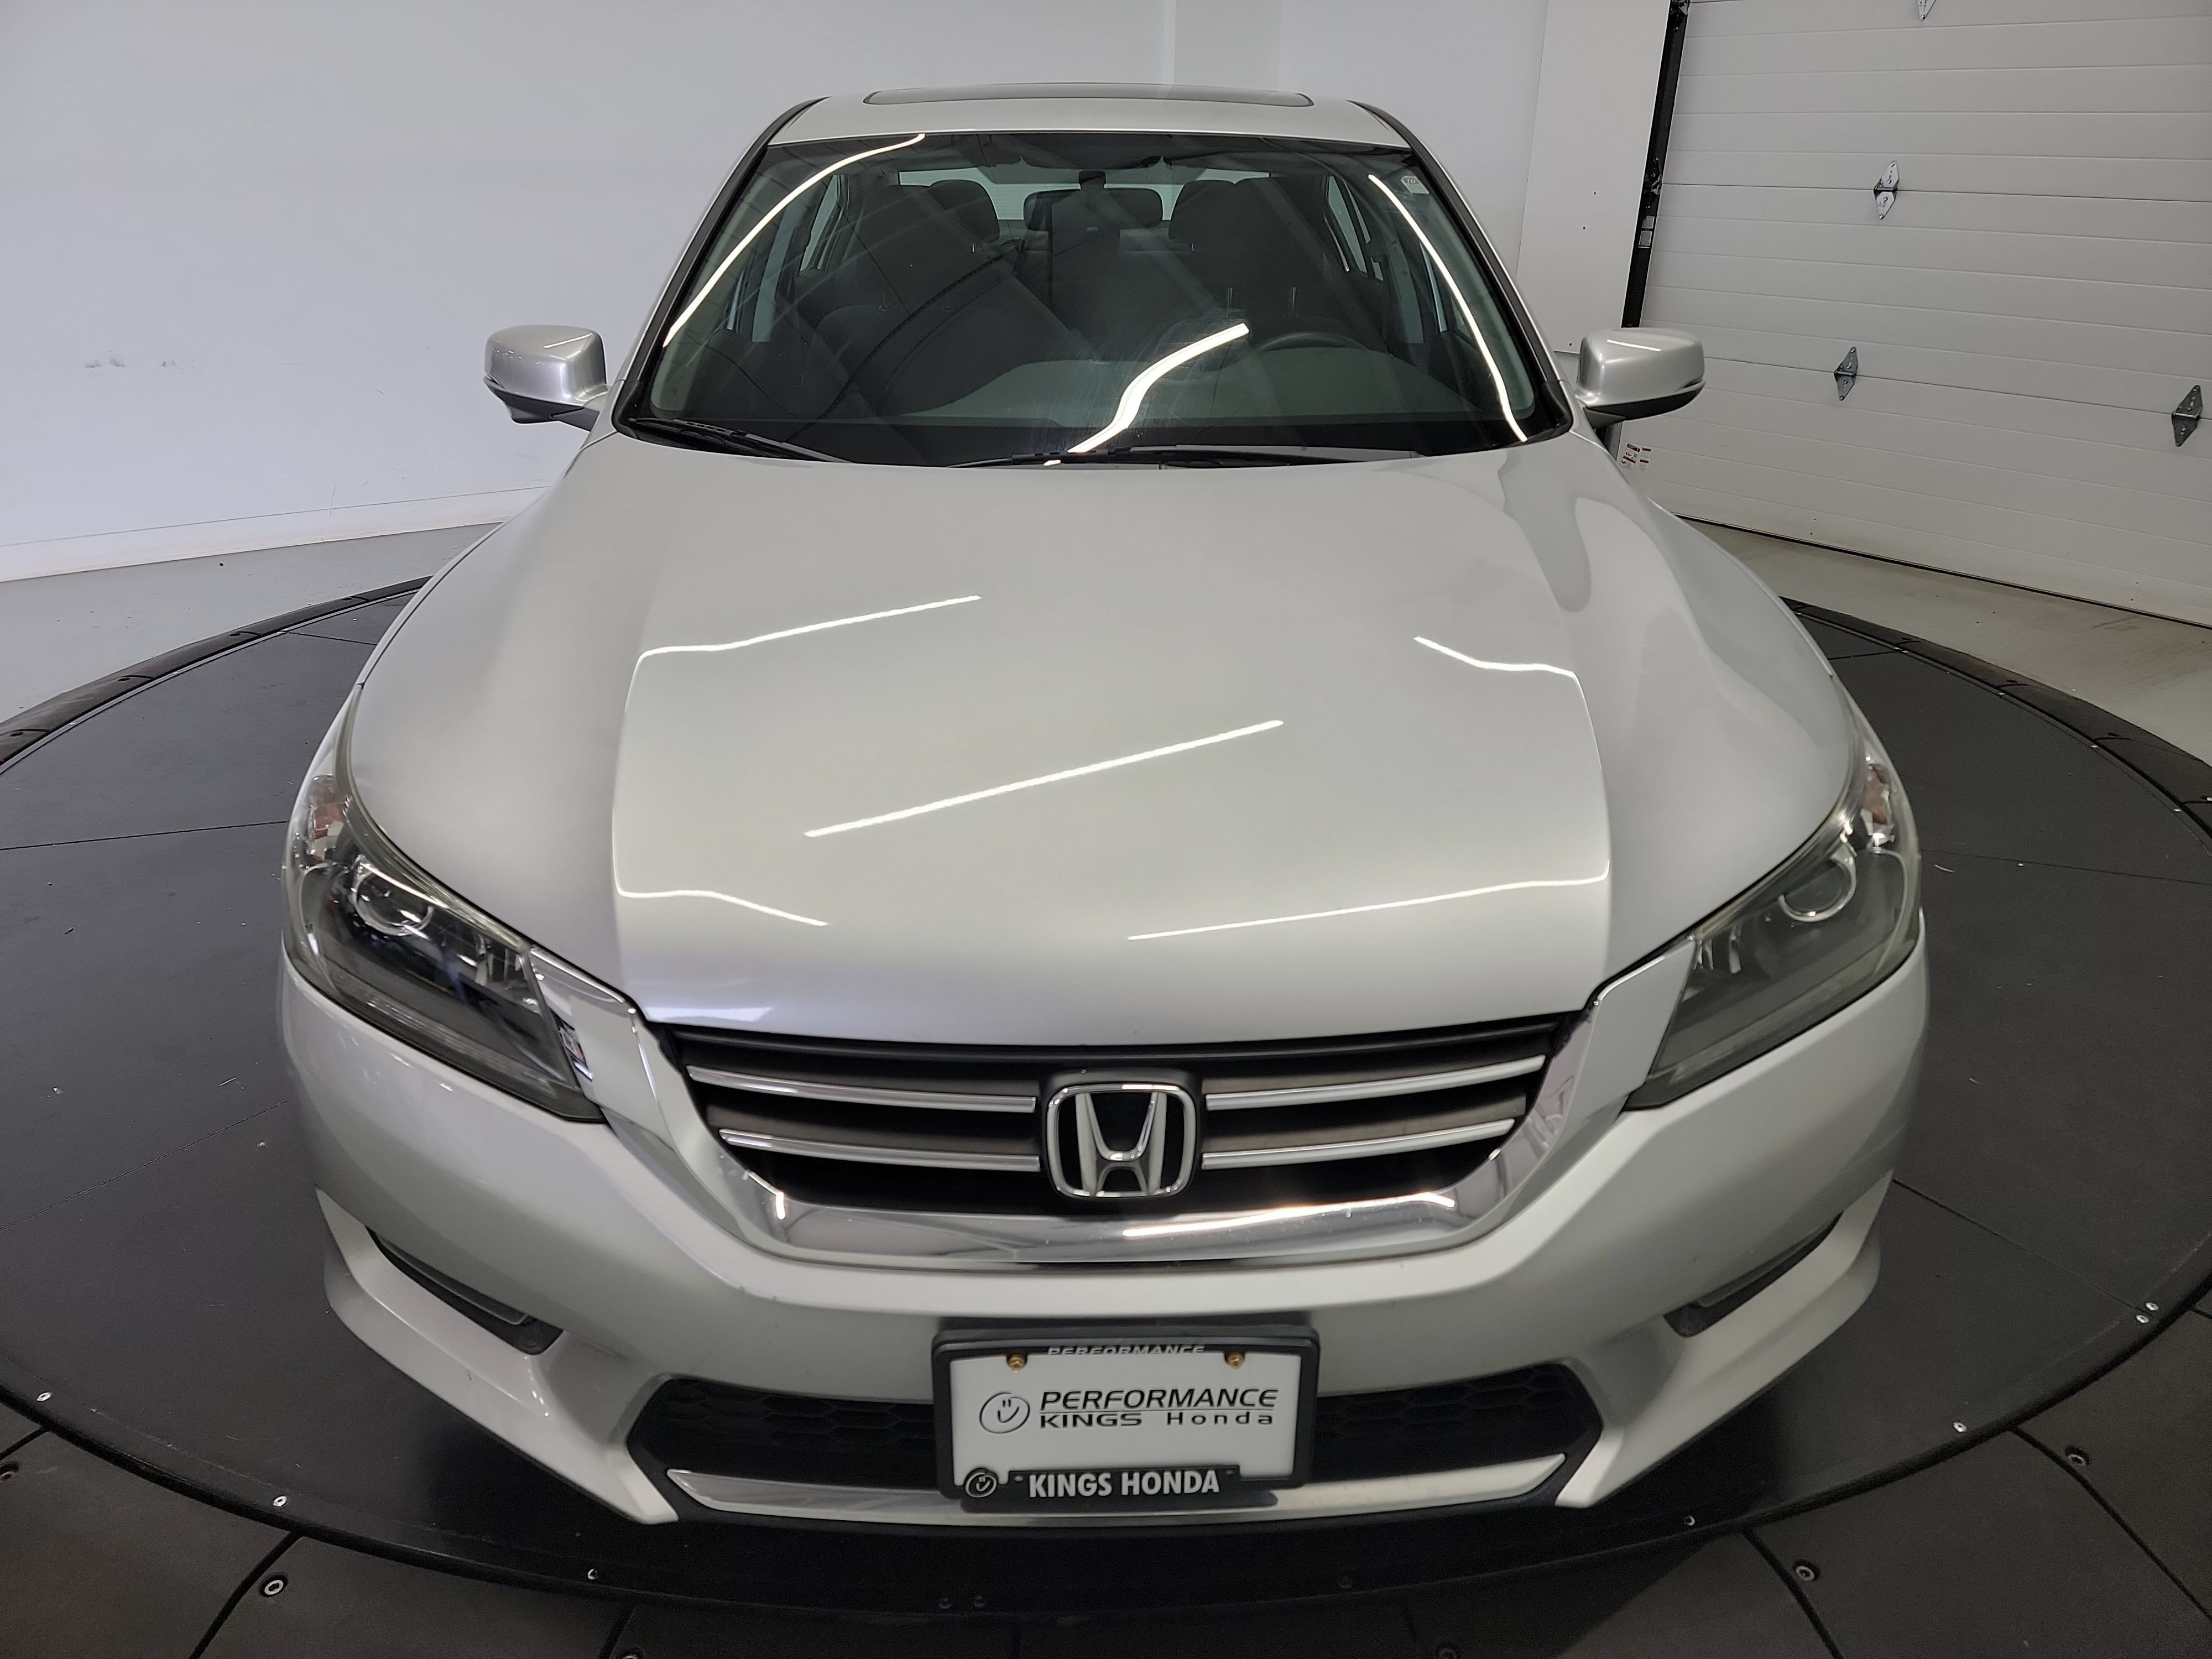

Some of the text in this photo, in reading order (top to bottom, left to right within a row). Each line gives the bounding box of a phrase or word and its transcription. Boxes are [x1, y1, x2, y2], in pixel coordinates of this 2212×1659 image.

[1040, 1389, 1279, 1410] PERFORMANCE
[1041, 1411, 1272, 1428] KINGS Honda
[1029, 1470, 1220, 1498] KINGS HONDA
